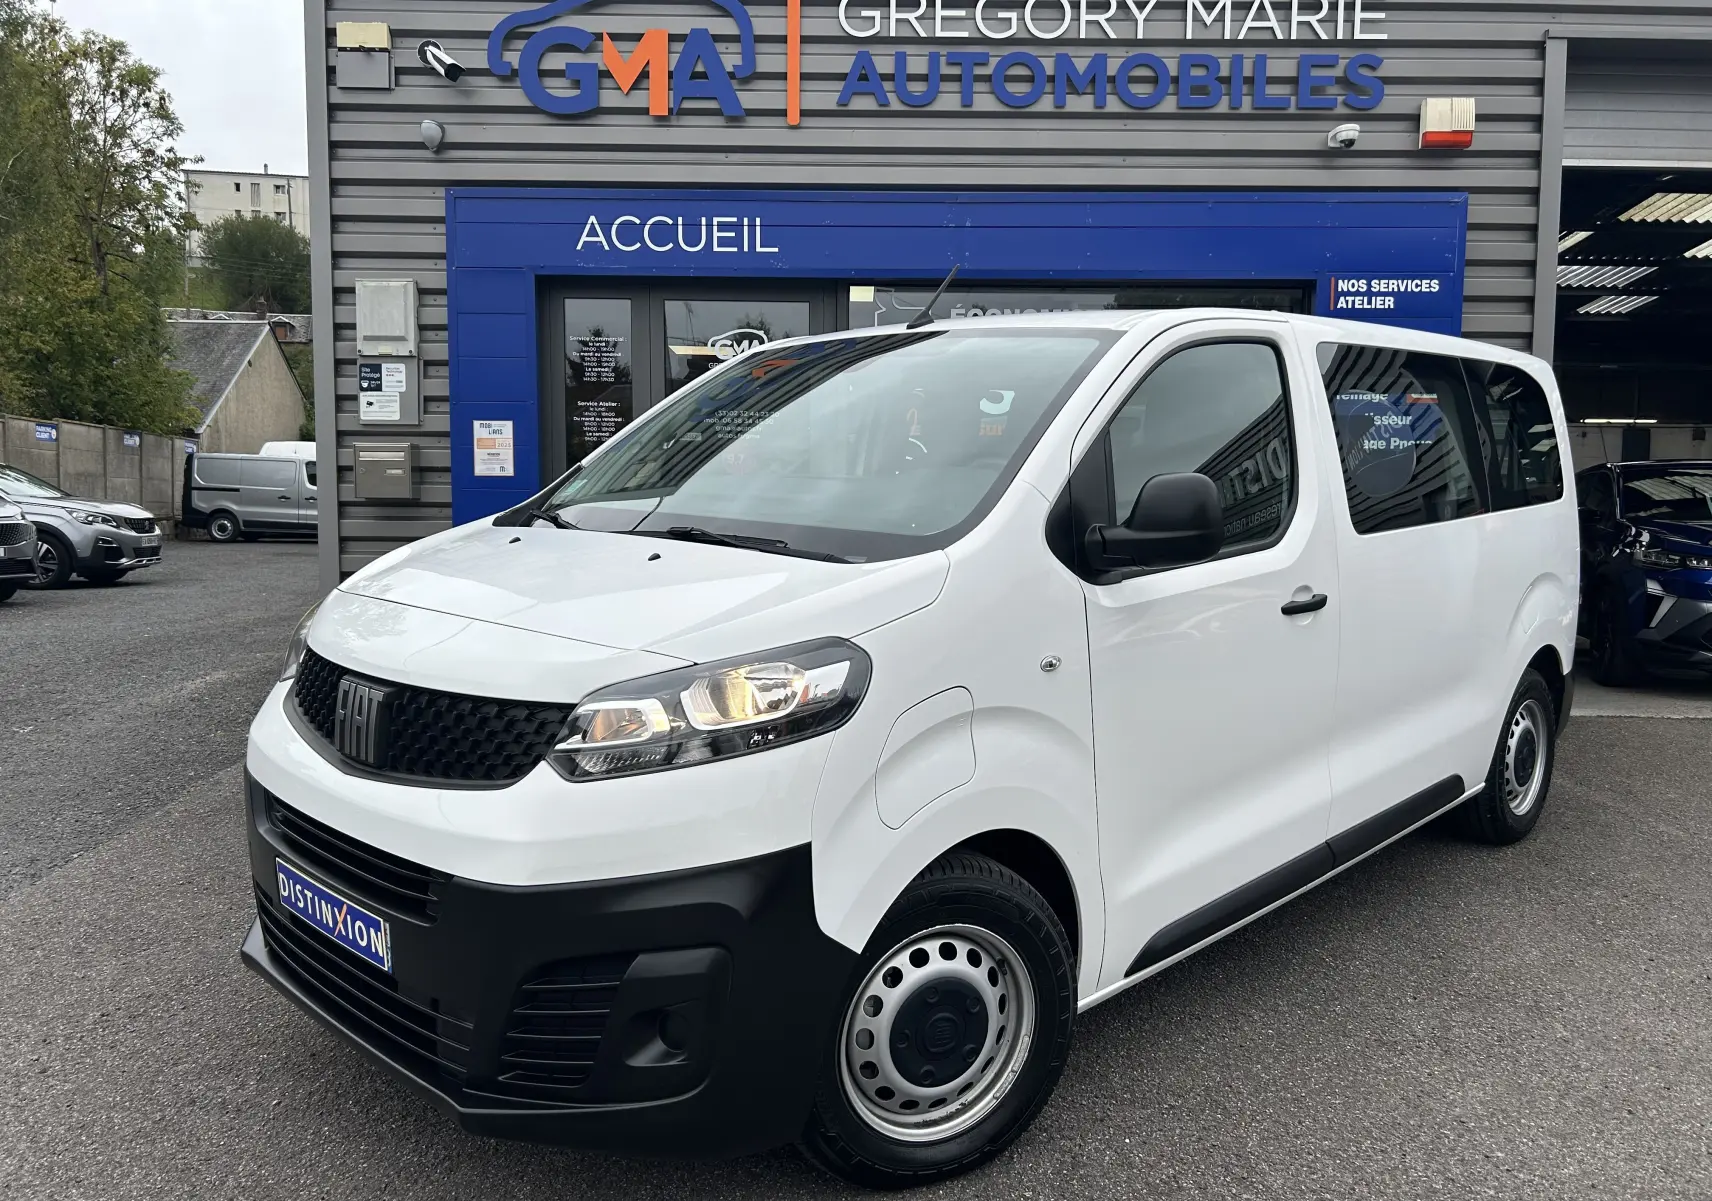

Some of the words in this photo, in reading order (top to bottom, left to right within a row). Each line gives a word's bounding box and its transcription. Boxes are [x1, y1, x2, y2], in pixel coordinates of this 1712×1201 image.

[838, 0, 1154, 39] GREGORY
[1185, 0, 1388, 39] MARIE
[518, 26, 746, 116] GMA
[836, 50, 1385, 110] AUTOMOBILES
[576, 215, 779, 252] ACCUEIL
[1337, 279, 1367, 292] NOS
[1370, 279, 1439, 292] SERVICES
[1337, 296, 1394, 309] ATELIER
[1366, 413, 1412, 425] sseur
[334, 677, 384, 764] FIAT
[279, 873, 384, 957] DISTINXION
